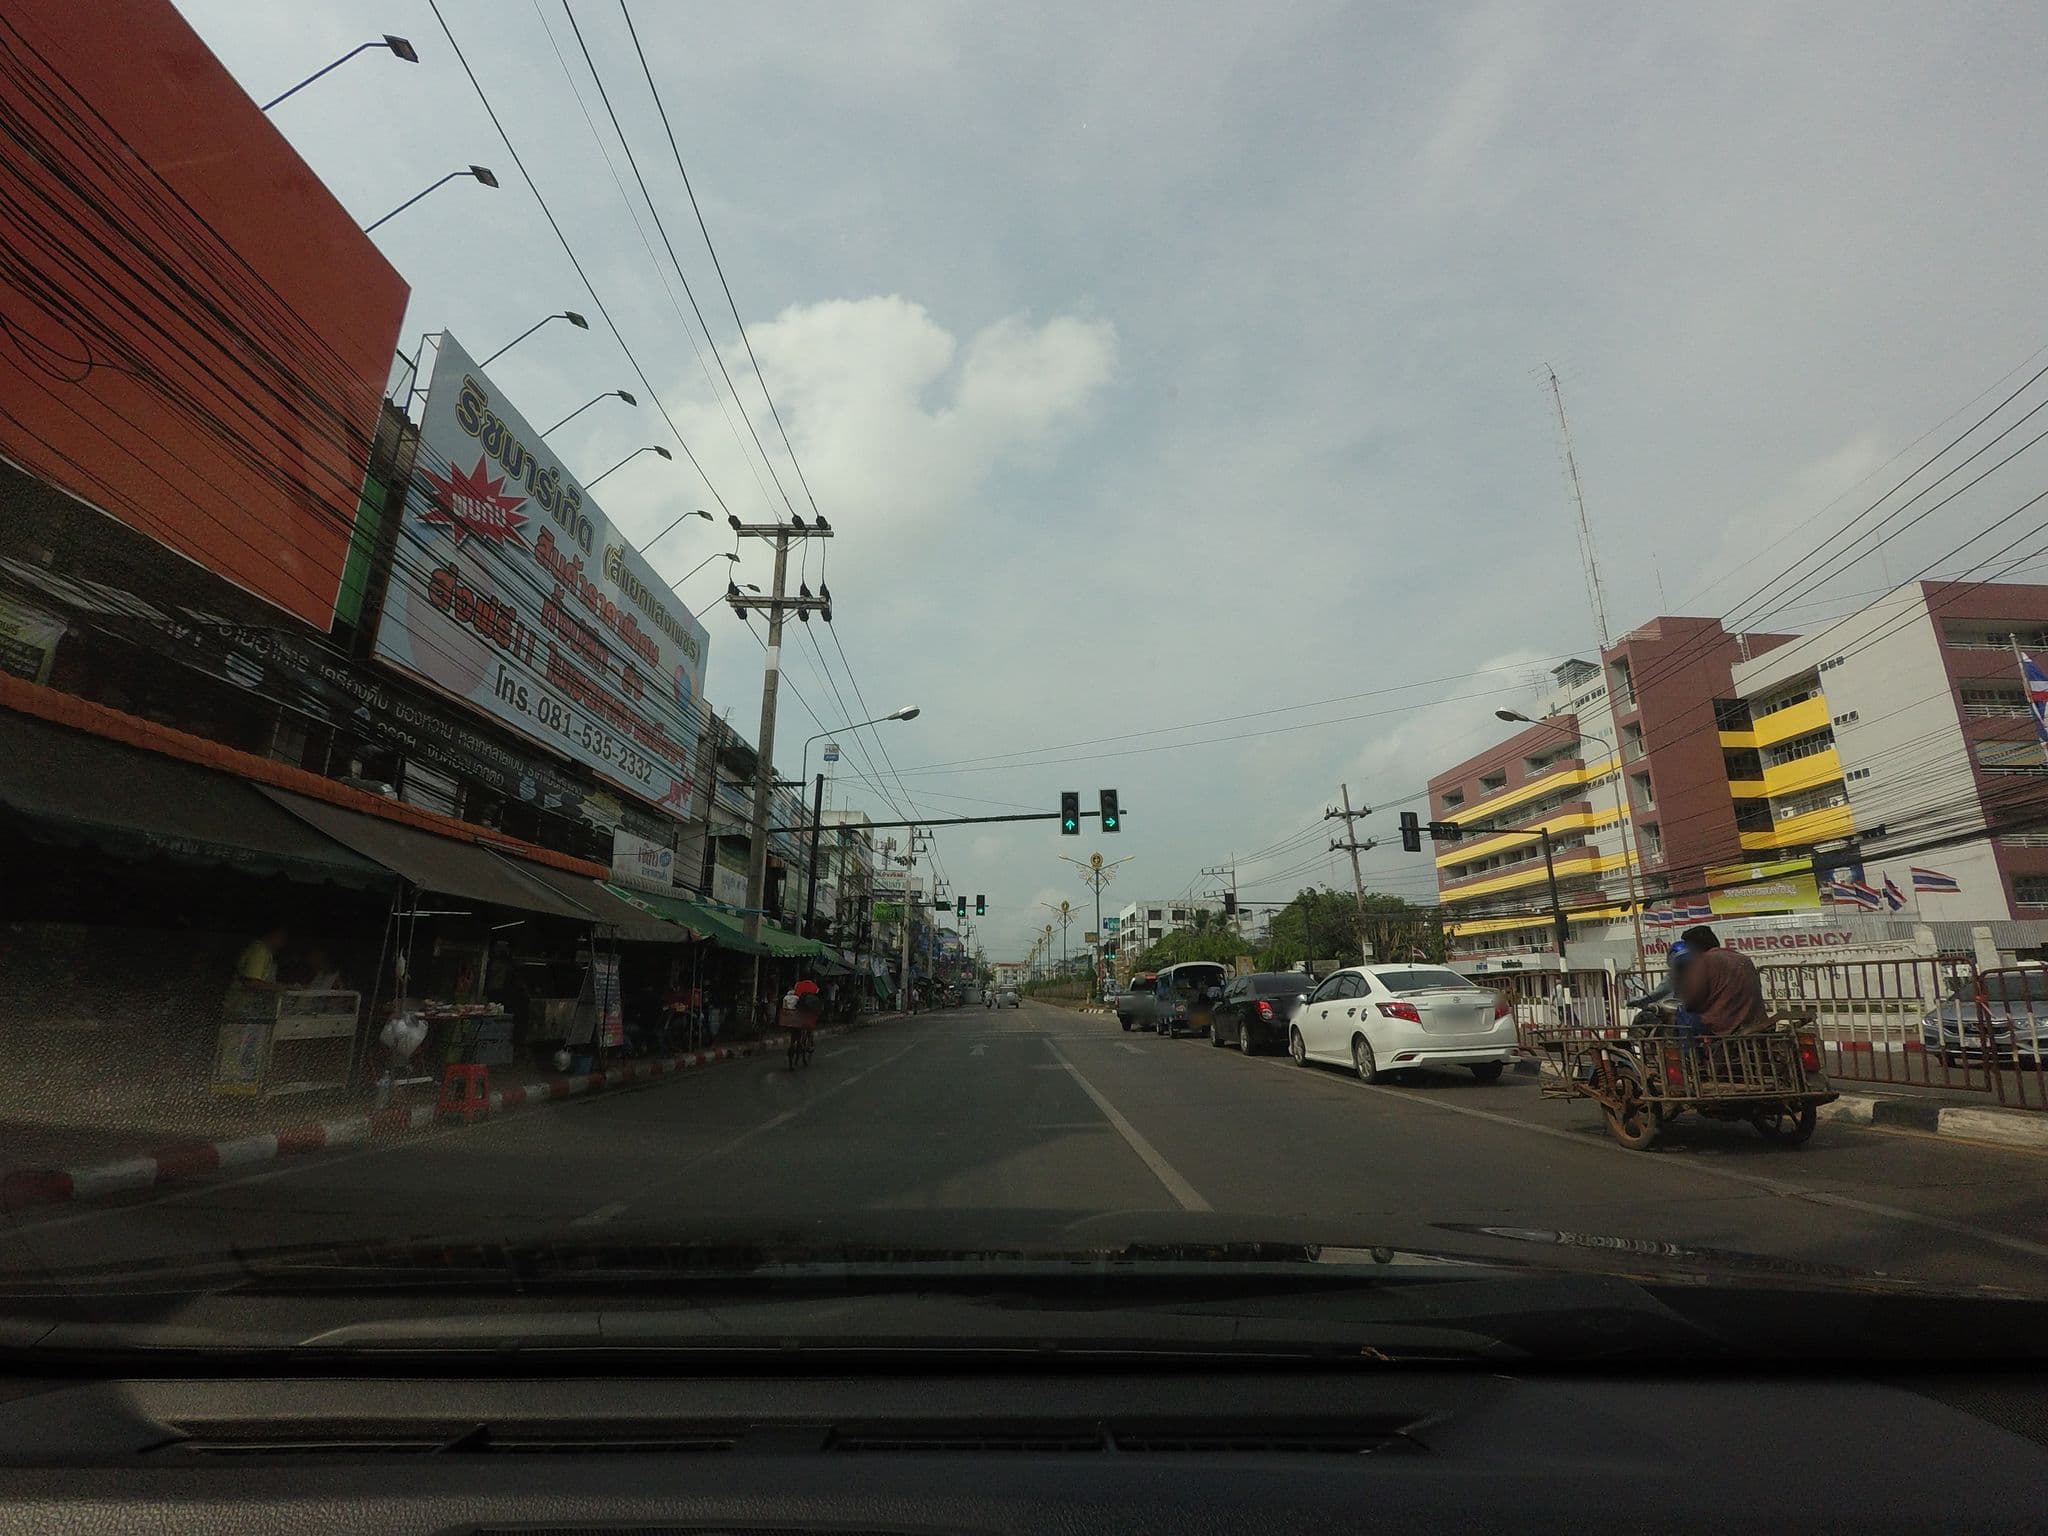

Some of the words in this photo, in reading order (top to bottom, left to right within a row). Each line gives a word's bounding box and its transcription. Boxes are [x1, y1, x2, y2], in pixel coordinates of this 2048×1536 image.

[493, 663, 532, 716] โทร.
[538, 701, 654, 785] 081-535-2332
[1724, 931, 1853, 951] EMERGENCY
